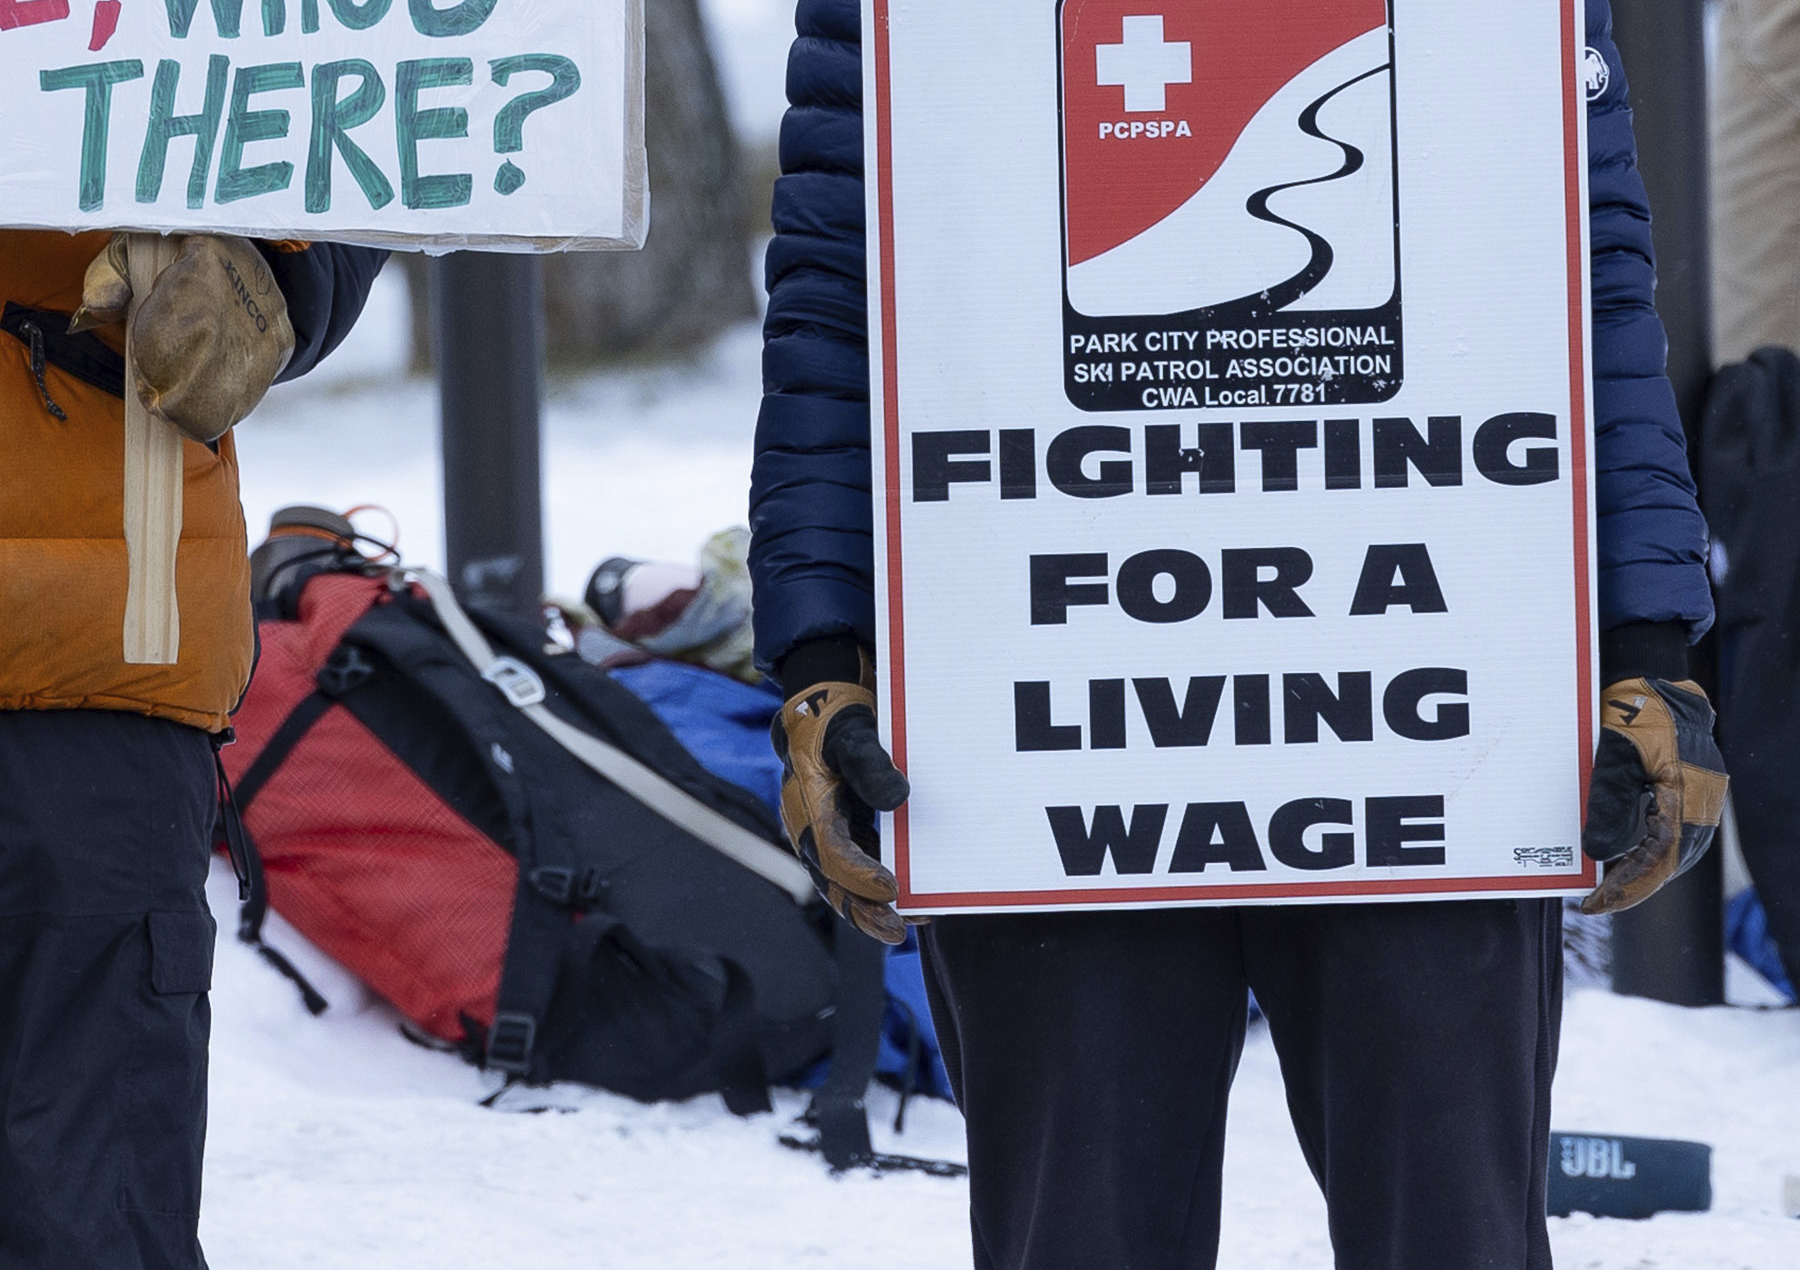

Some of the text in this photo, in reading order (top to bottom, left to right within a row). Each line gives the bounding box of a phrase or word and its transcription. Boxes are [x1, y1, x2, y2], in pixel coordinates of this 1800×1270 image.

[39, 53, 583, 214] THERE?
[1099, 120, 1192, 139] PCPSPA
[1070, 326, 1394, 354] PARK CITY PROFESSIONAL
[1074, 355, 1391, 383] SKI PATROL ASSOCIATION
[1142, 384, 1326, 407] CWA Local 7781
[911, 412, 1559, 503] FIGHTING
[1029, 543, 1448, 626] FOR A
[1014, 667, 1470, 752] LIVING
[1045, 794, 1445, 877] WAGE
[1559, 1136, 1636, 1179] JBL
